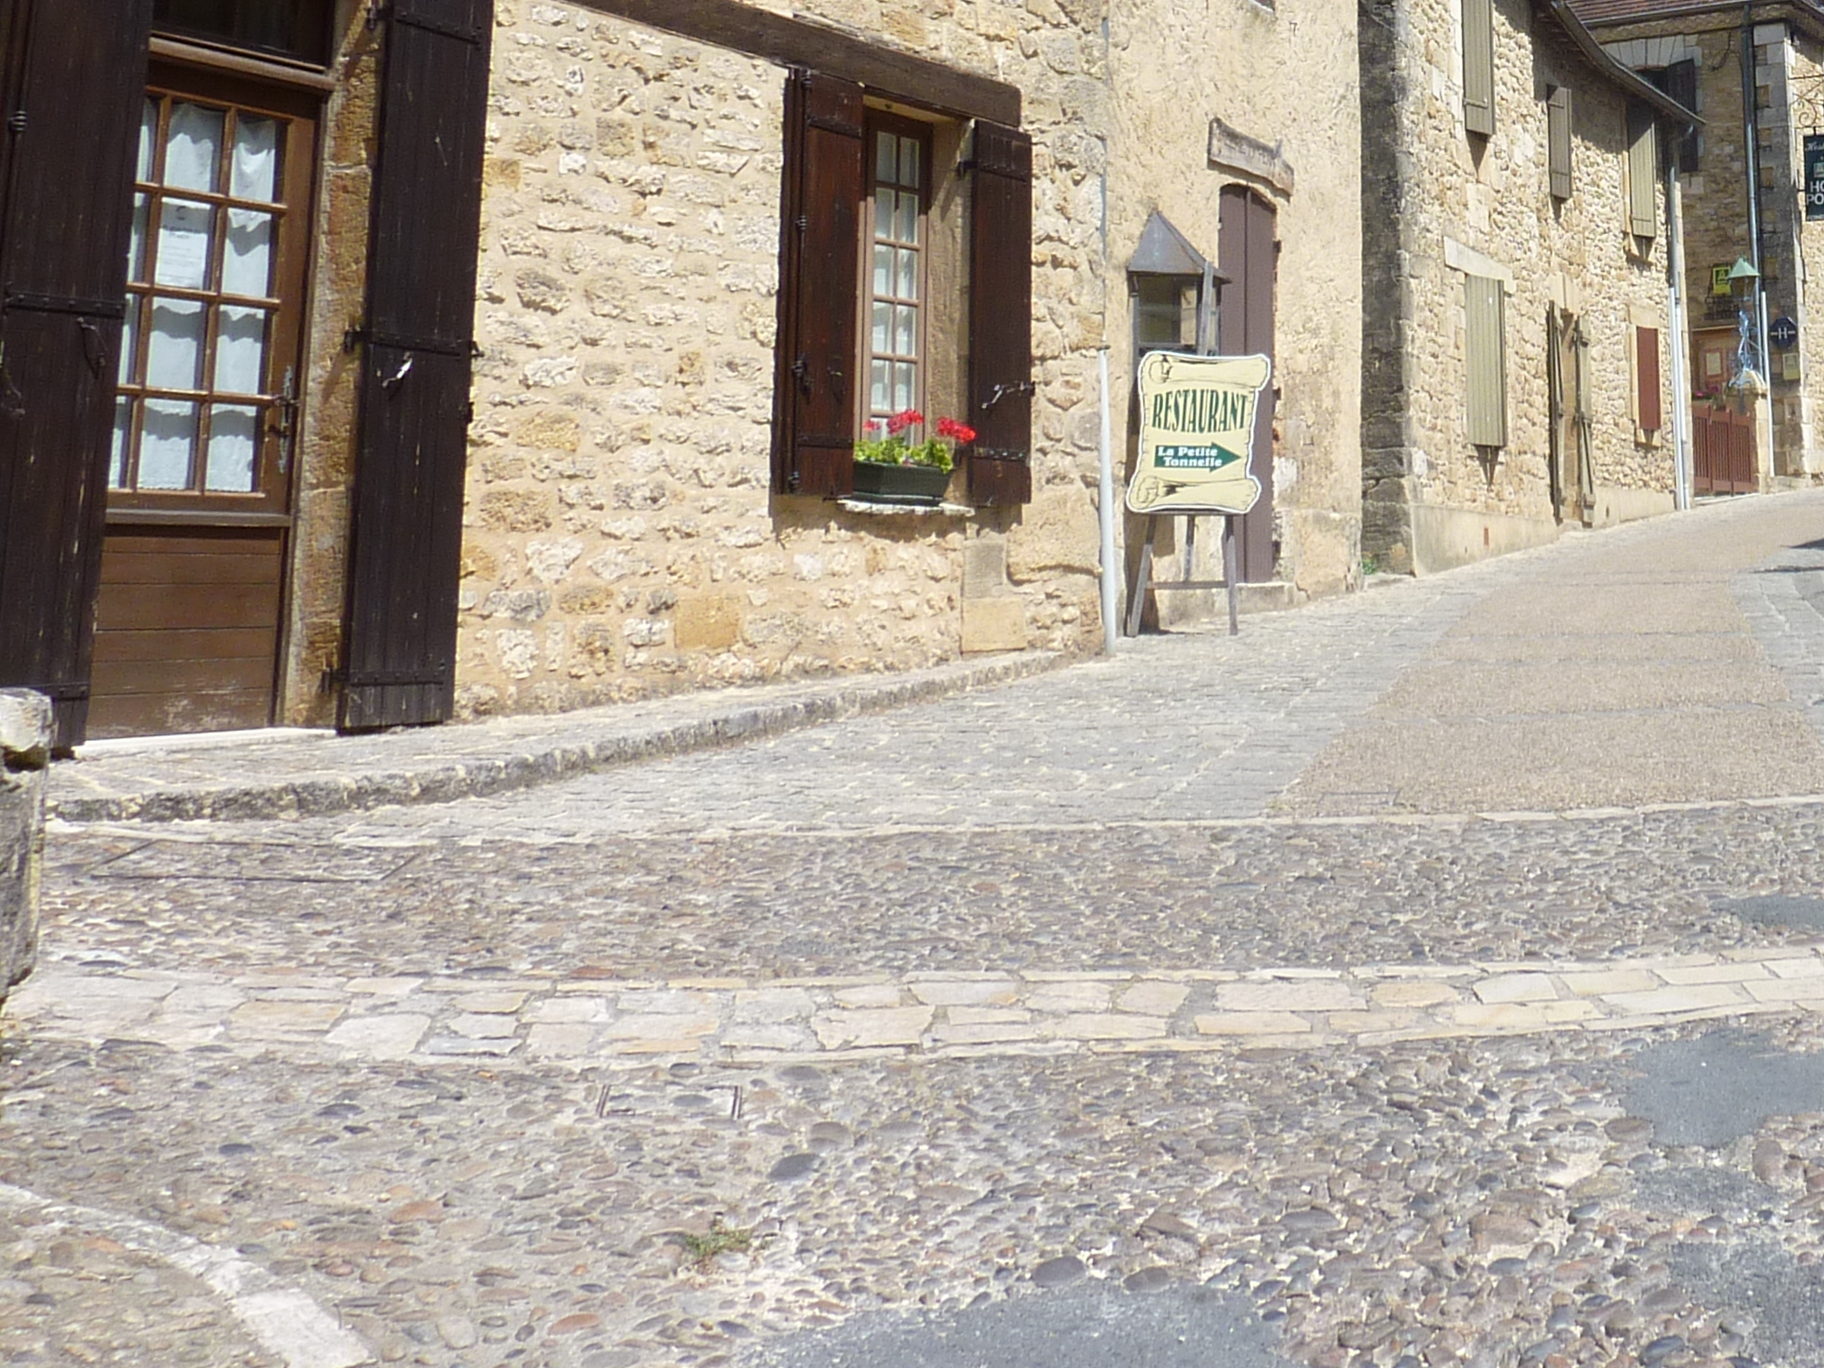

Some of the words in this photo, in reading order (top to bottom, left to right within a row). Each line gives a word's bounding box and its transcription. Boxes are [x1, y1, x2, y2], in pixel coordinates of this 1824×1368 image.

[1151, 389, 1248, 434] RESTAURANT
[1157, 446, 1175, 457] La
[1178, 445, 1218, 457] Petite
[1162, 456, 1223, 468] Tonnelle
